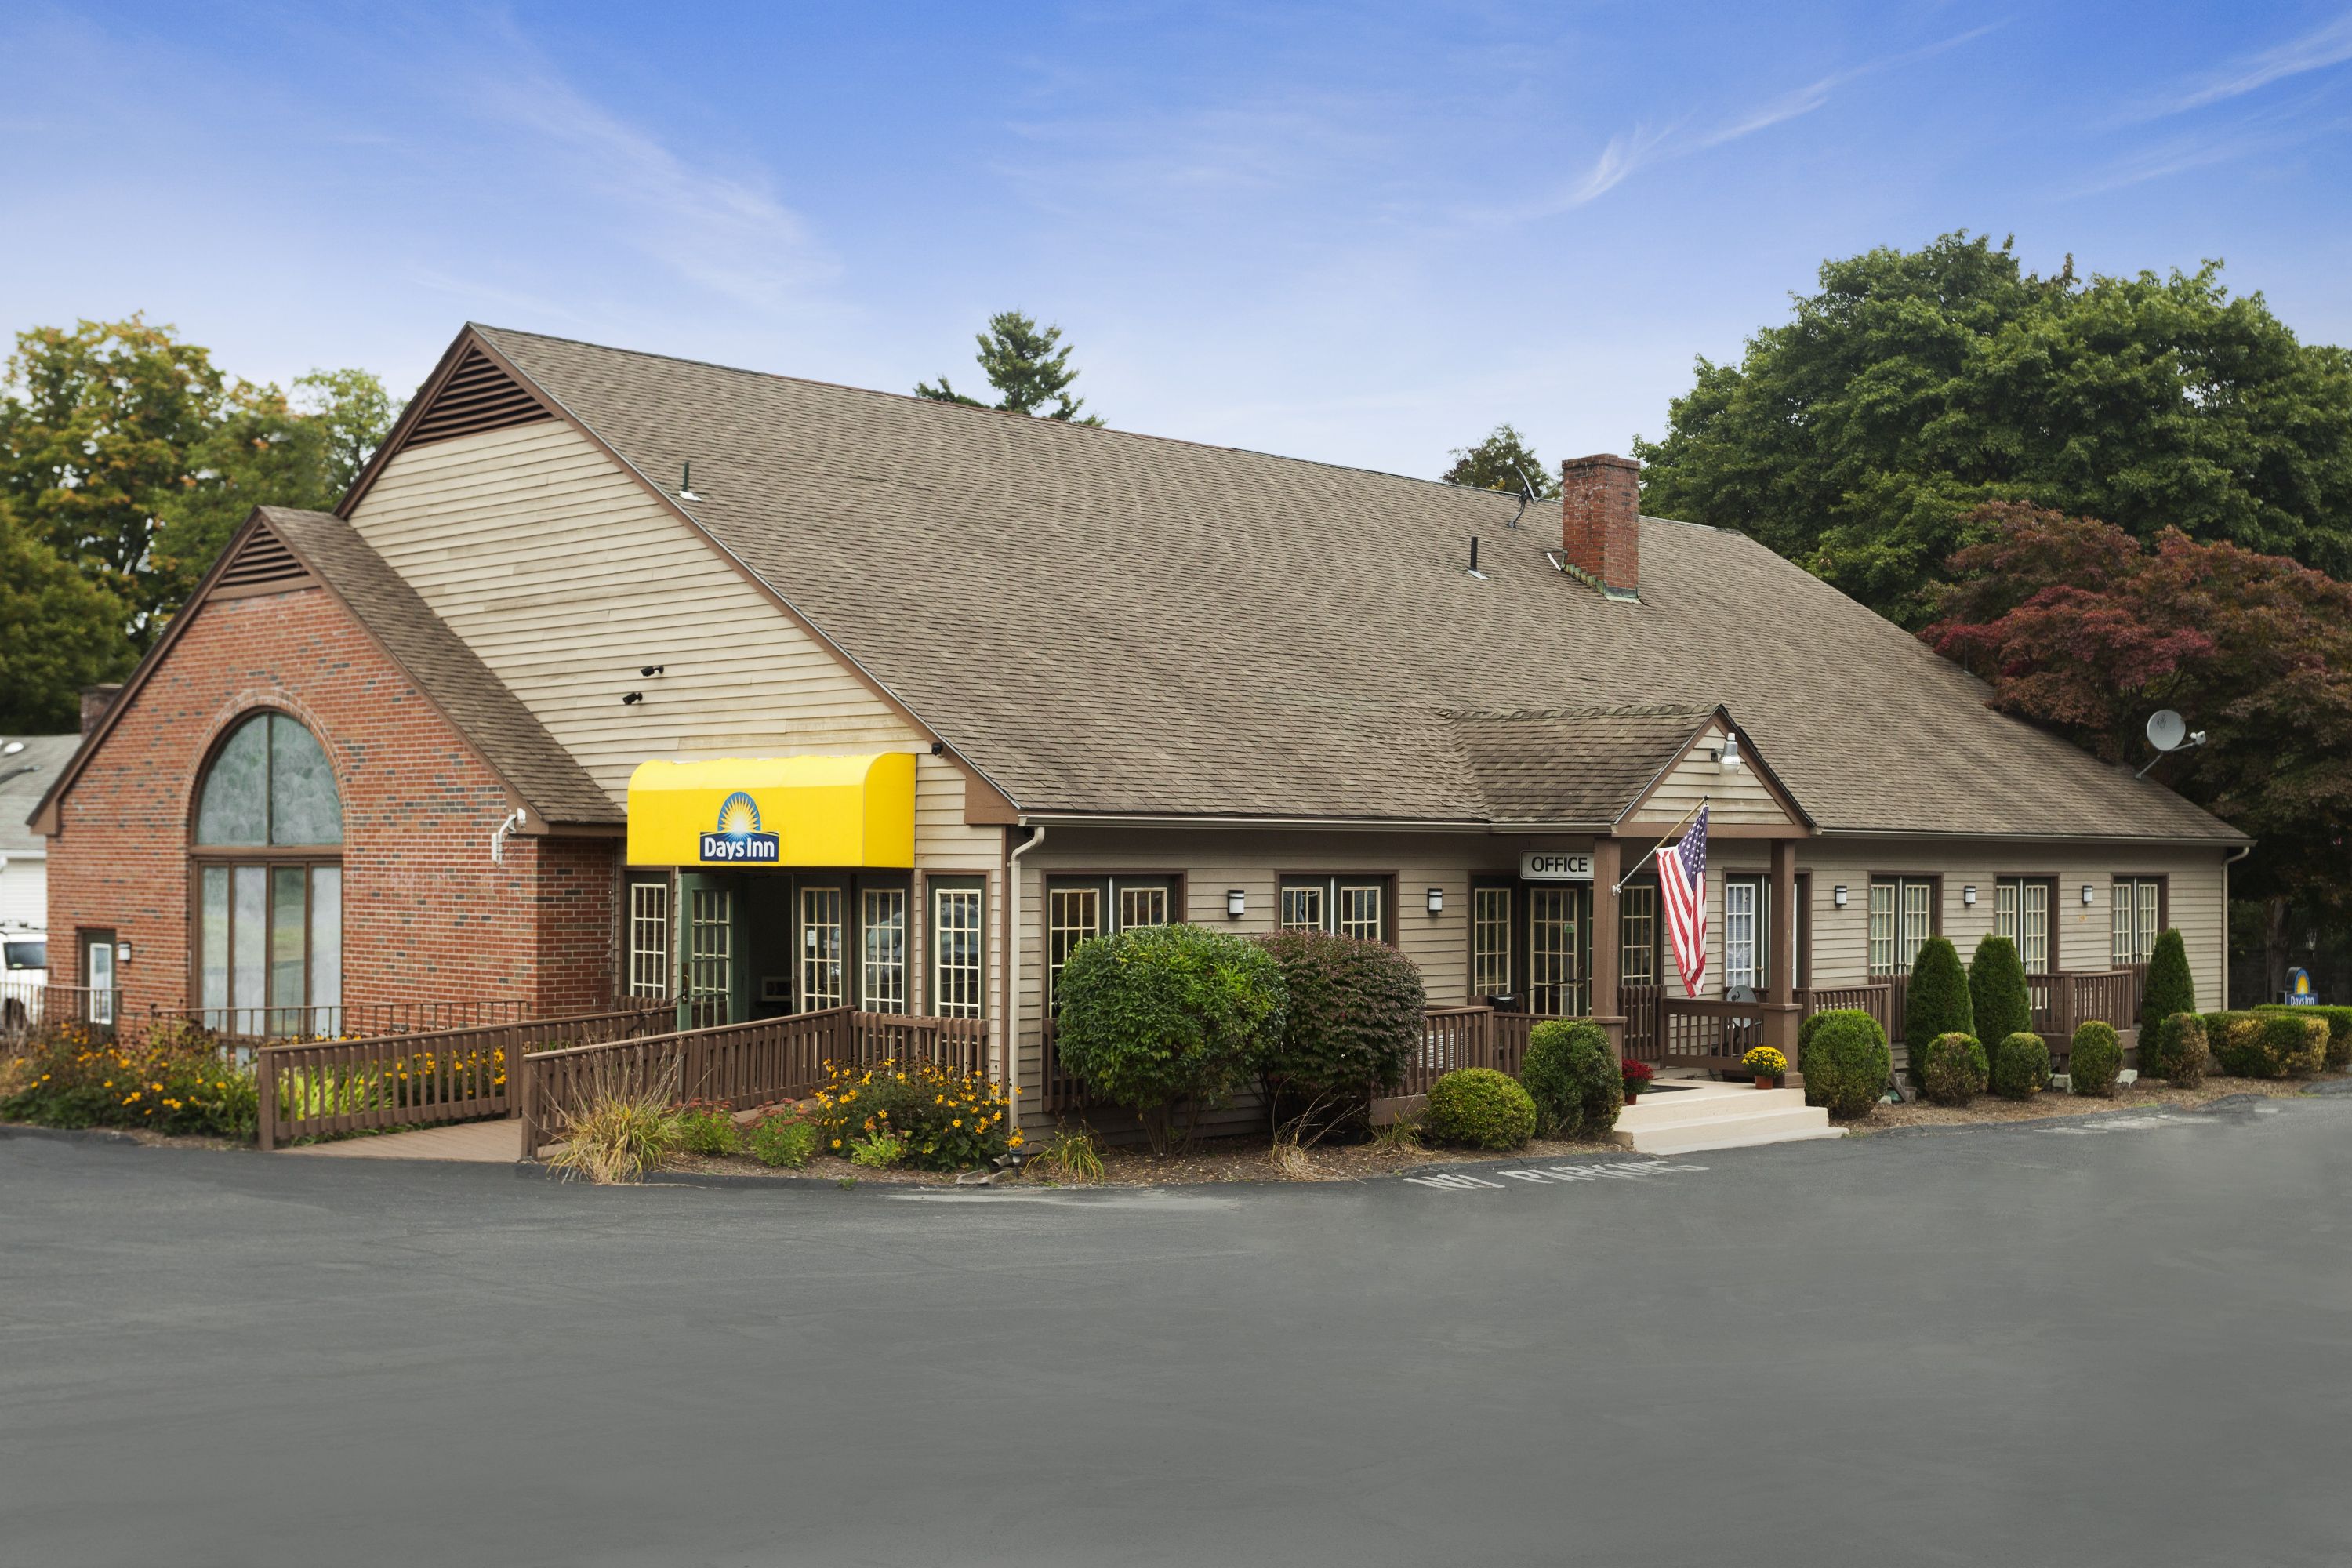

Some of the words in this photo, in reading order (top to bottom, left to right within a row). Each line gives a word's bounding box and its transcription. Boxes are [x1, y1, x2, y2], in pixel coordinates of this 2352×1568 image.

[704, 837, 745, 860] Days
[746, 837, 775, 857] Inn
[1531, 856, 1588, 873] OFFICE
[2290, 996, 2305, 1006] Days
[2305, 995, 2314, 1006] Inn
[1497, 1160, 1710, 1184] PARKING
